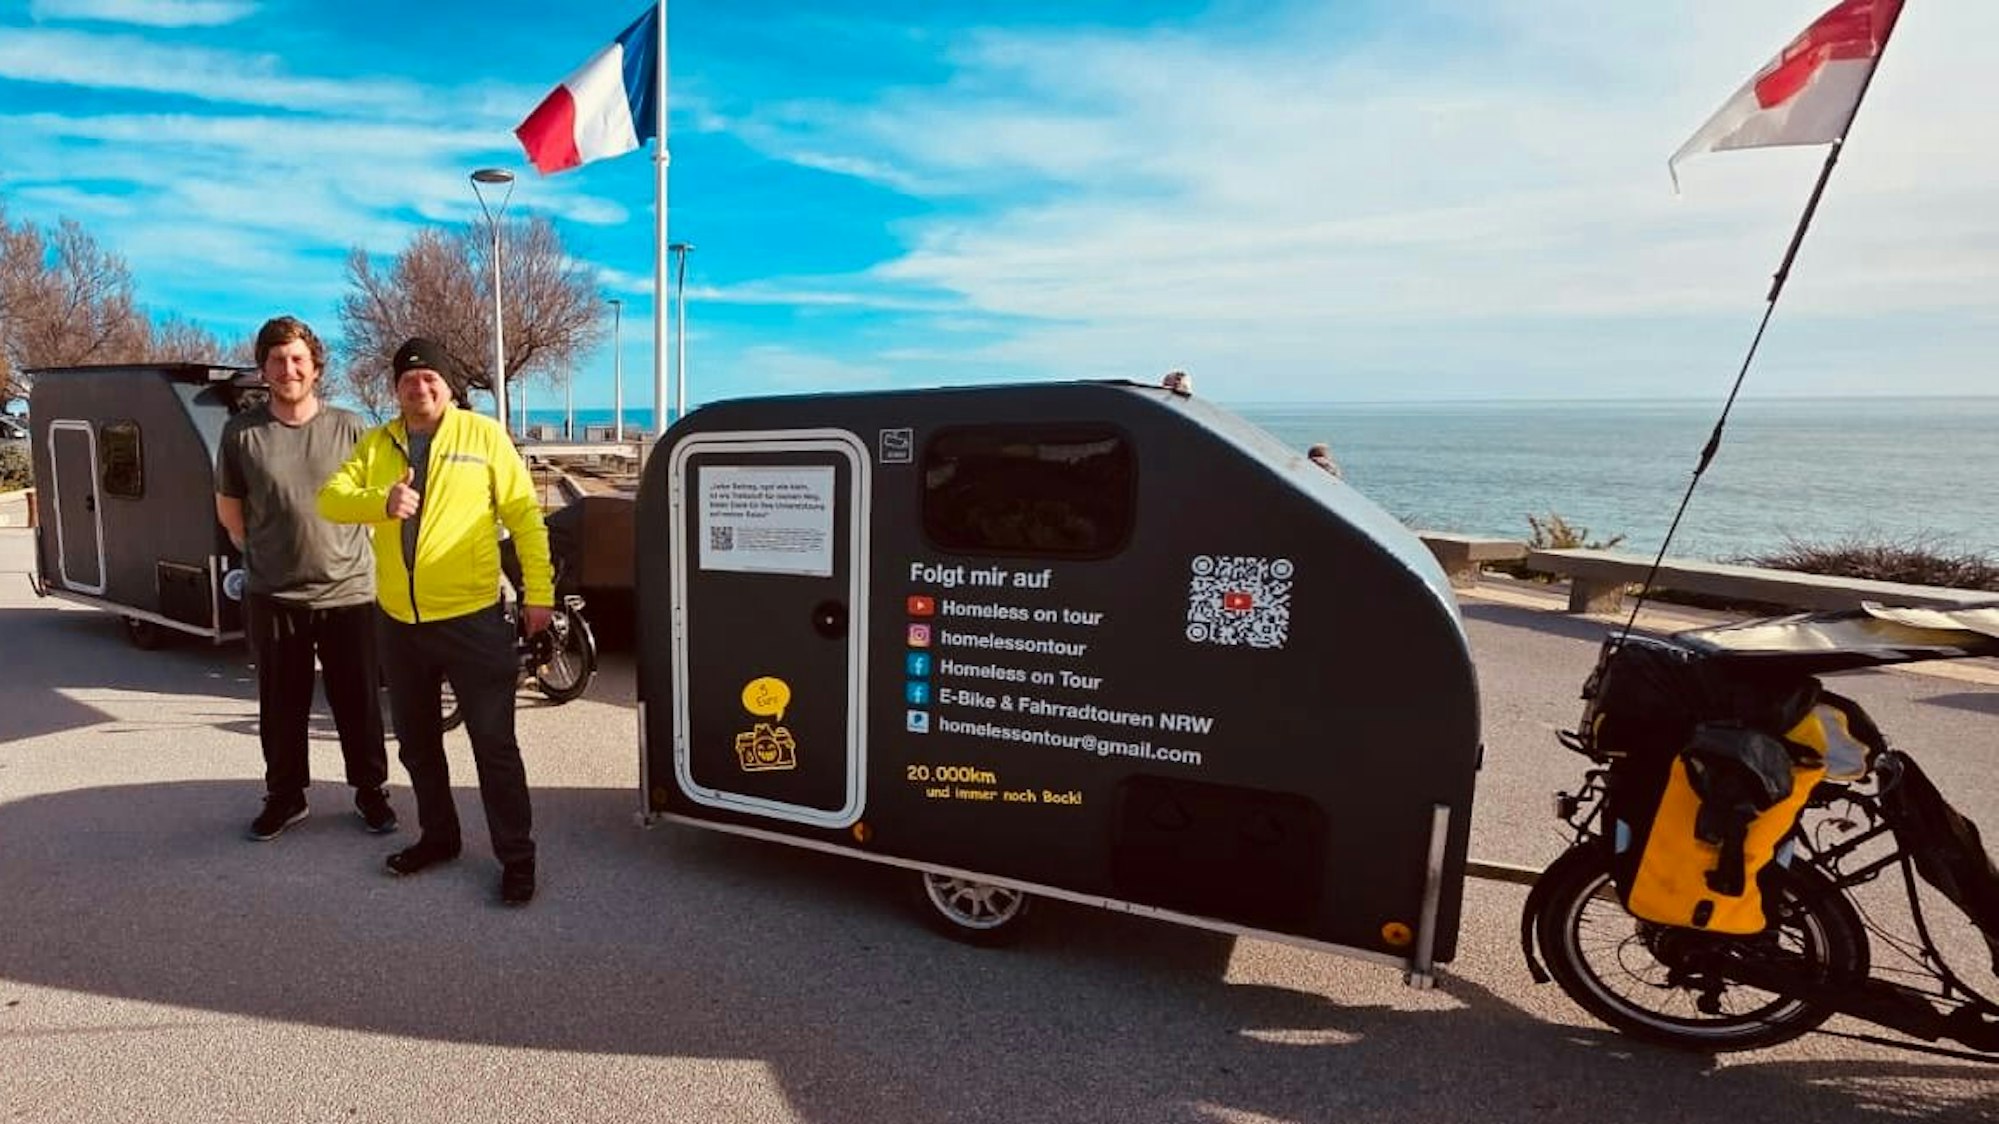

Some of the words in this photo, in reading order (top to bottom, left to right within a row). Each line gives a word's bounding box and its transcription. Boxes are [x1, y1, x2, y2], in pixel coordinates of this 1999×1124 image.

[911, 563, 964, 587] Folgt
[971, 567, 1007, 586] mir
[1013, 569, 1051, 588] auf
[943, 600, 1029, 620] Homeless
[1034, 610, 1057, 622] on
[1063, 609, 1102, 624] tour
[942, 631, 1086, 656] homelessontour
[941, 660, 1026, 681] Homeless
[1031, 672, 1054, 684] on
[1060, 671, 1102, 689] Tour
[940, 689, 996, 709] E-Bike
[1001, 696, 1012, 710] &
[1018, 697, 1153, 727] Fahrradtouren
[1160, 714, 1213, 733] NRW
[939, 717, 1201, 765] homelessontour@gmail.com
[907, 765, 996, 784] 20.000km
[926, 786, 950, 797] und
[955, 788, 997, 799] immer
[1004, 789, 1036, 802] noch
[1043, 790, 1081, 804] Bock!
